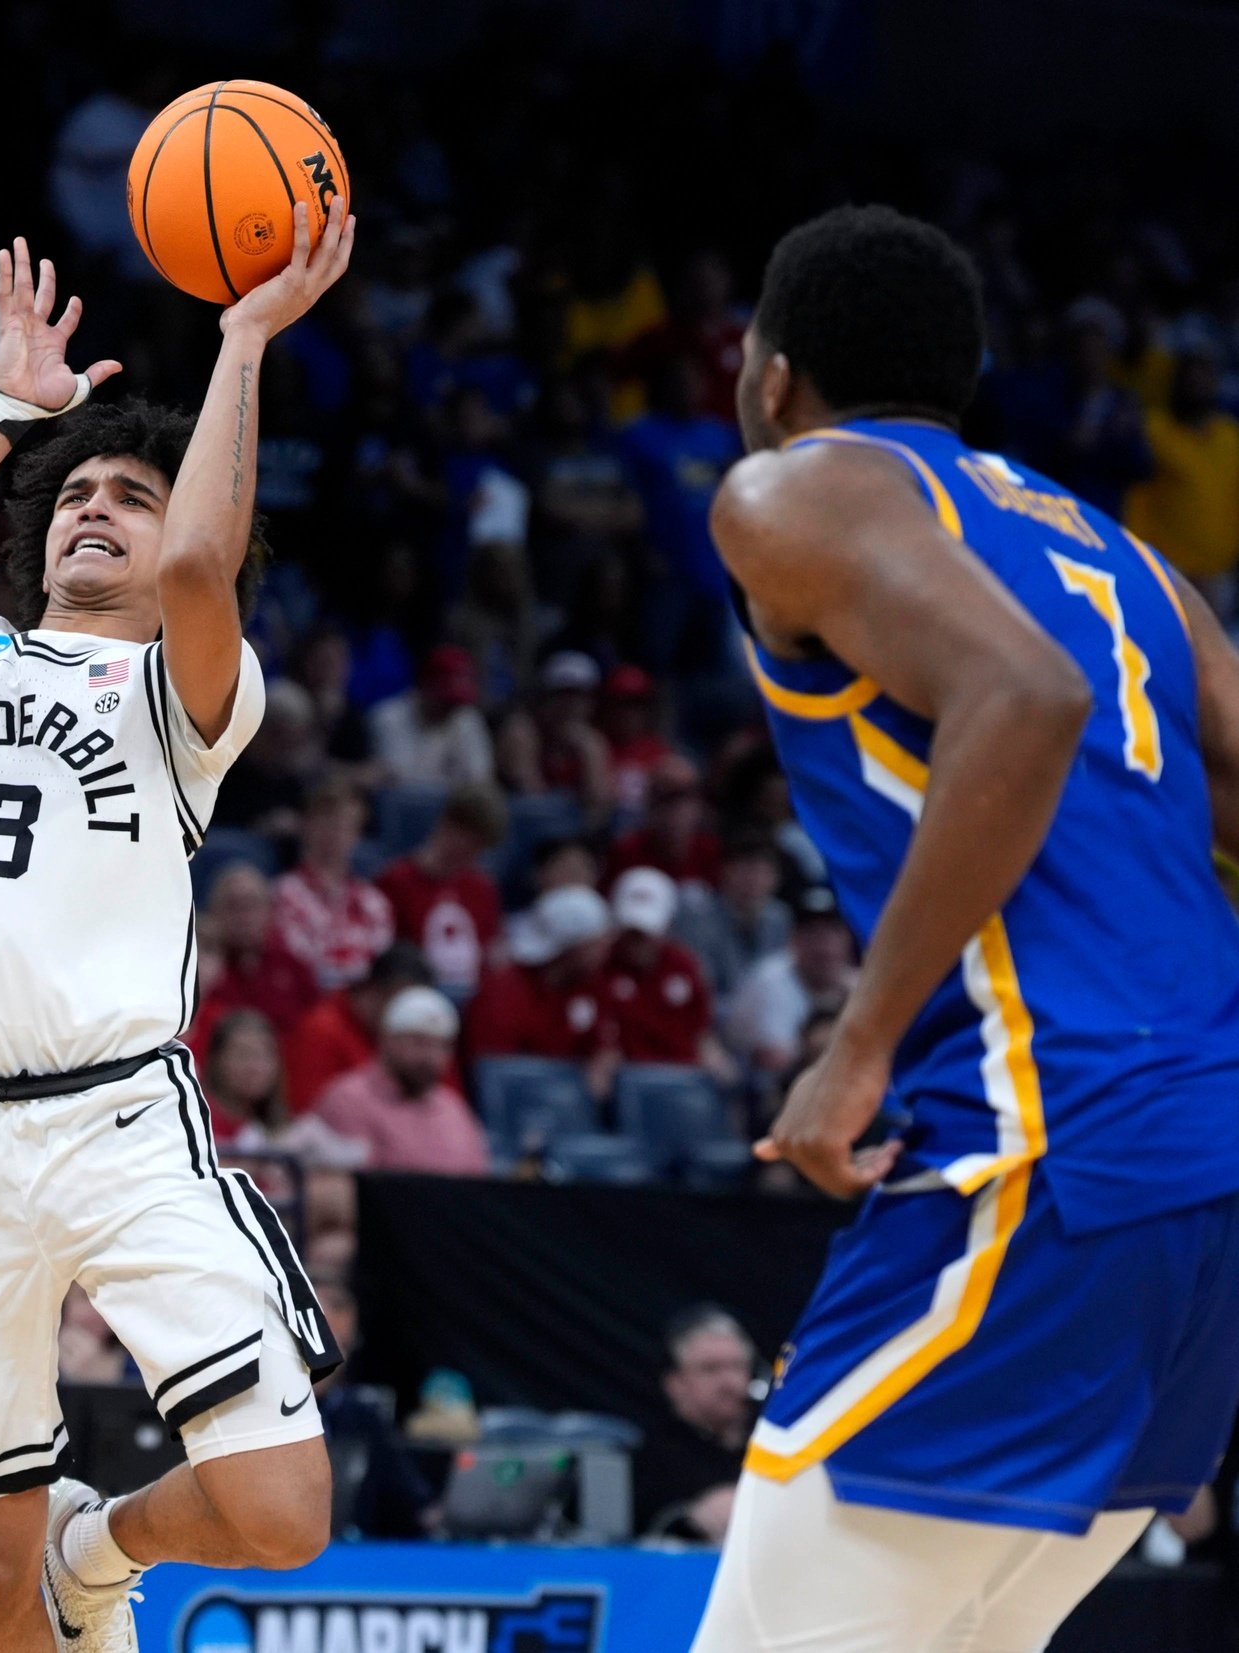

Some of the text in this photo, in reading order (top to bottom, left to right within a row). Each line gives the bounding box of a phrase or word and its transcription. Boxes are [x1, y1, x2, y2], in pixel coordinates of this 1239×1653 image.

[296, 160, 317, 203] OFFICIAL
[96, 693, 119, 713] SEC
[256, 1605, 488, 1653] MARCH
